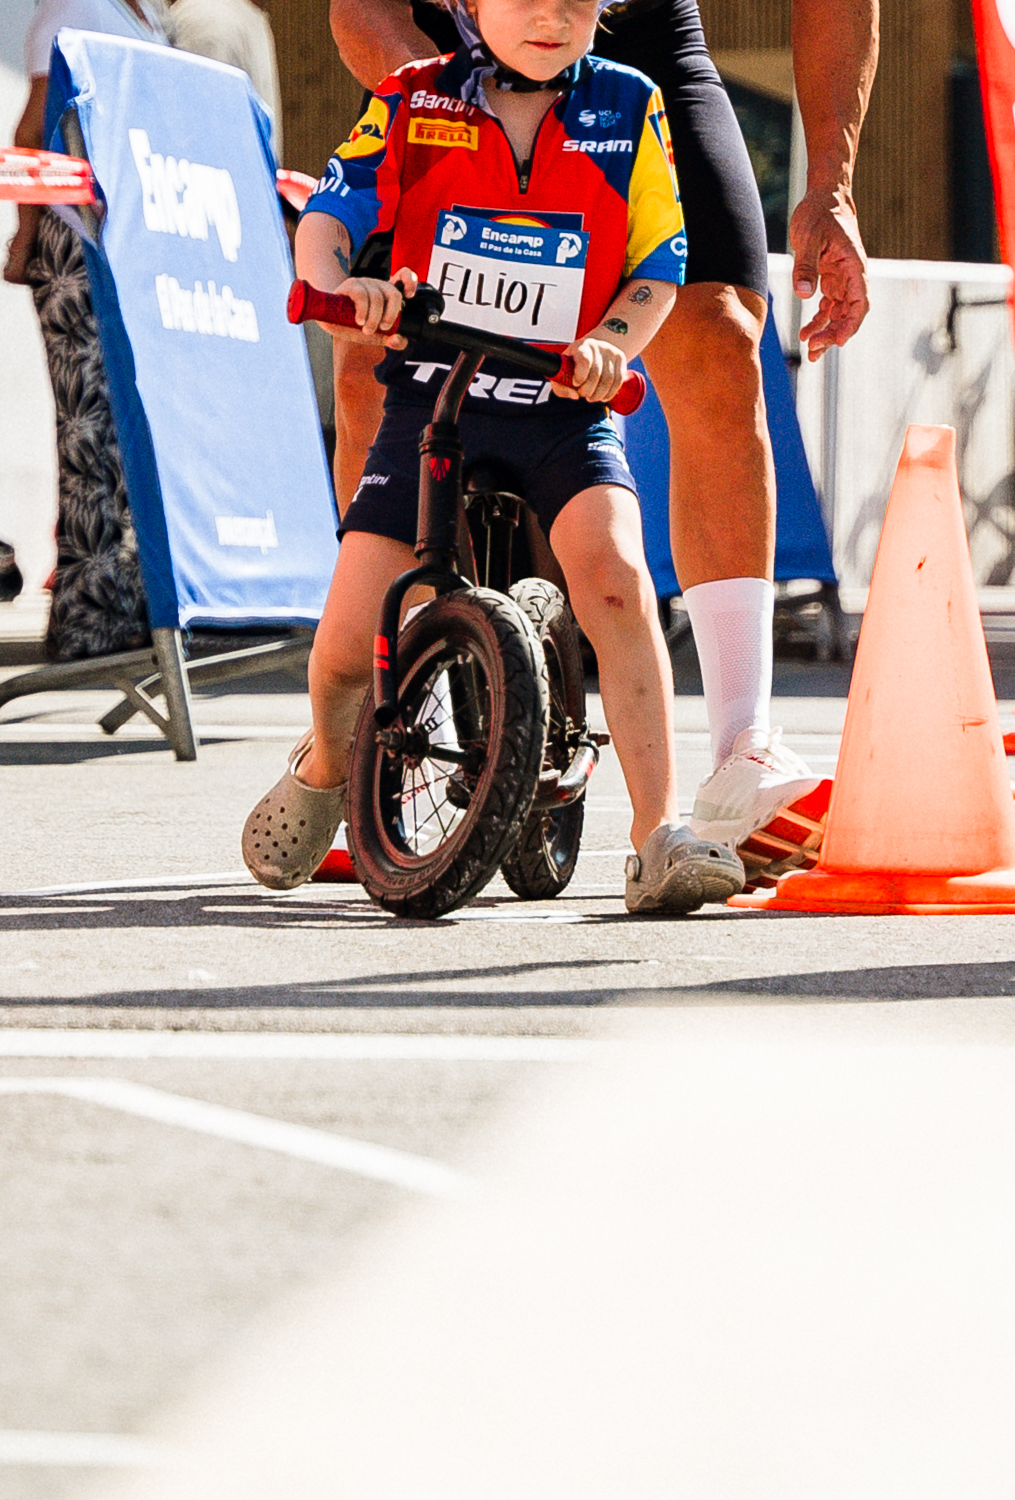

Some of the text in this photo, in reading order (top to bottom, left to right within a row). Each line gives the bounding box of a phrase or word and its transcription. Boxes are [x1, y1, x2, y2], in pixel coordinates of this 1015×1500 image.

[414, 122, 472, 144] PIRELLI
[562, 139, 633, 153] SRAM
[481, 227, 544, 249] Encamp
[488, 244, 502, 252] Pas
[523, 249, 542, 257] Casa
